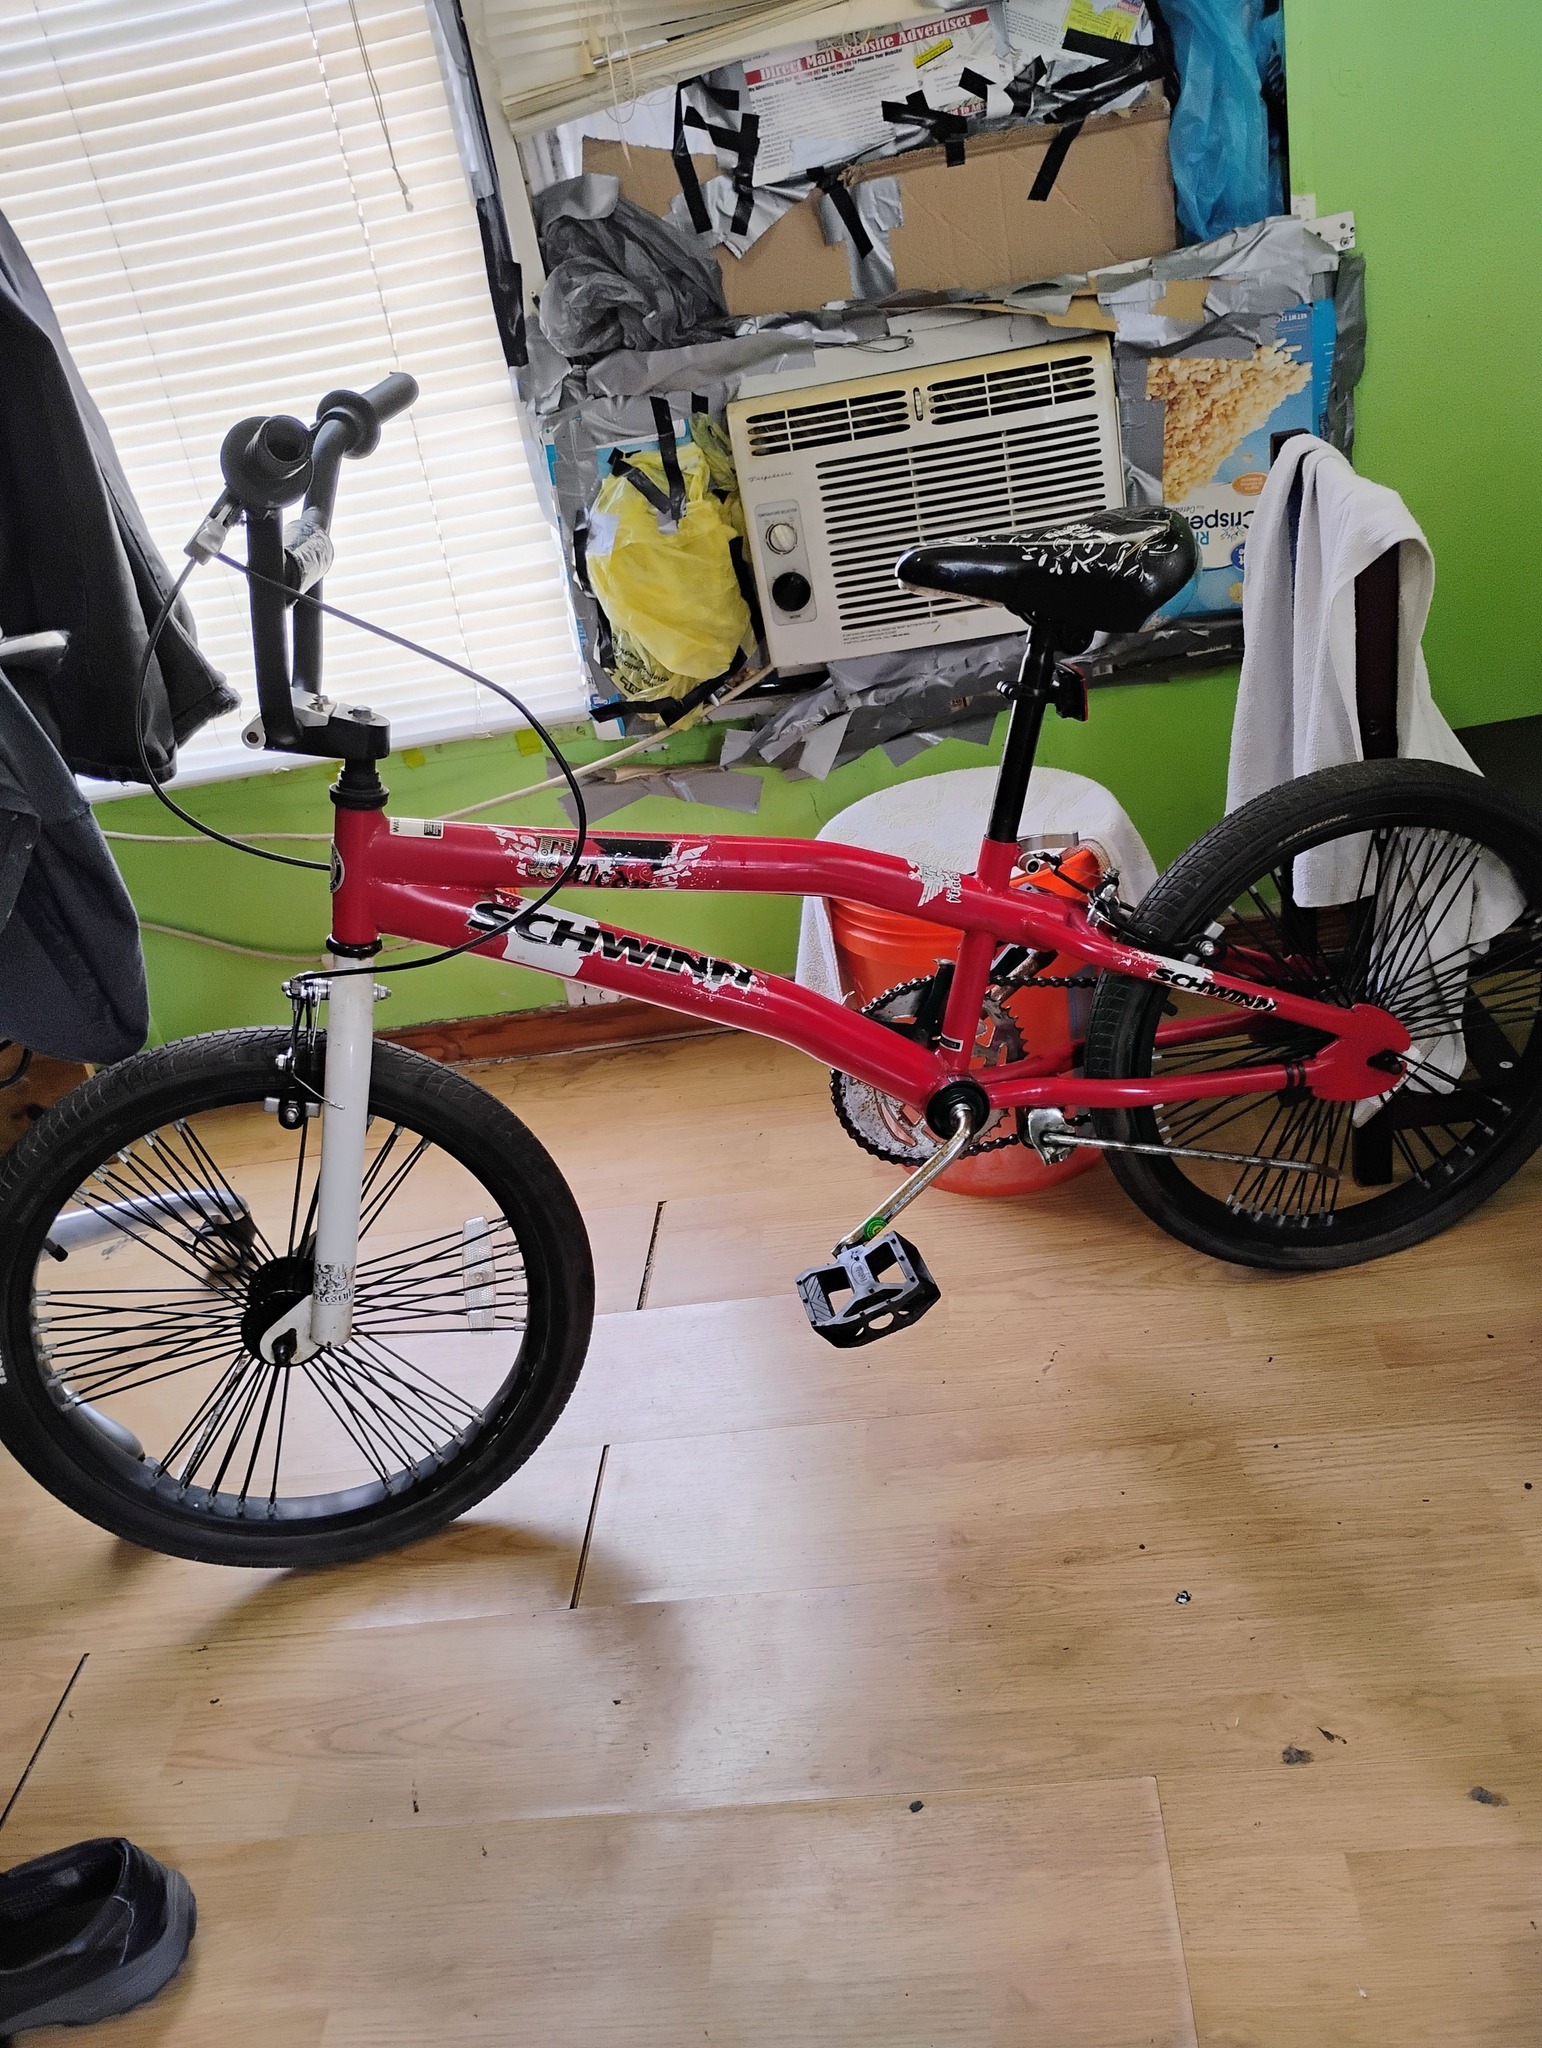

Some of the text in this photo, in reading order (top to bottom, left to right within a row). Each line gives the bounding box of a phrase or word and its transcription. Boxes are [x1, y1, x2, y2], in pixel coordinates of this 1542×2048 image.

[760, 13, 973, 80] Direct Mail Website Advertiser
[466, 901, 752, 989] SCHWINN
[1151, 967, 1278, 1012] SCHWINN
